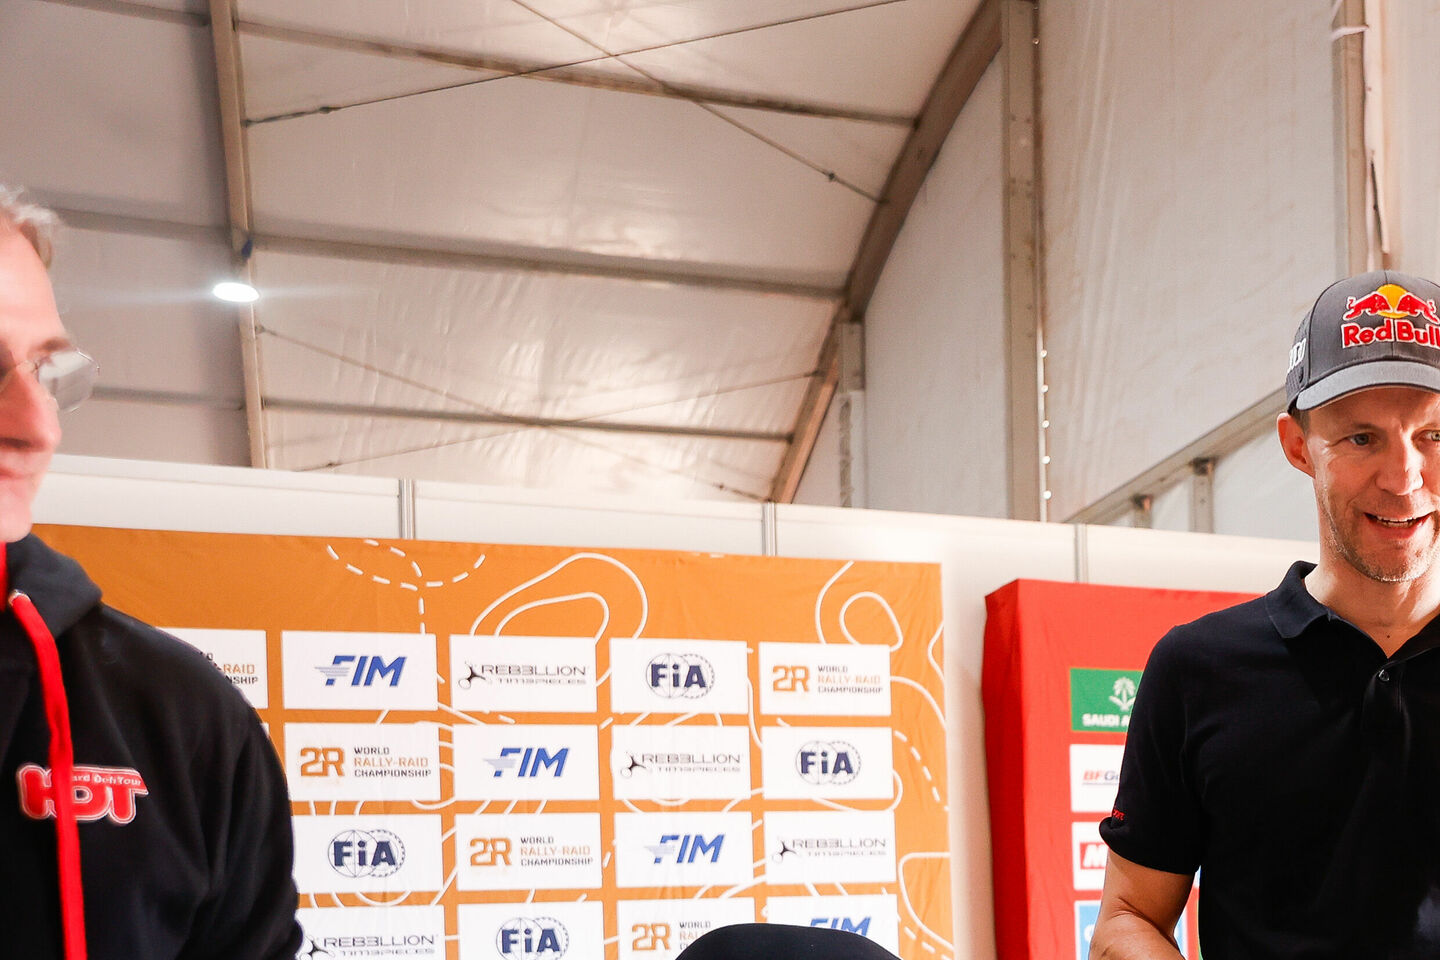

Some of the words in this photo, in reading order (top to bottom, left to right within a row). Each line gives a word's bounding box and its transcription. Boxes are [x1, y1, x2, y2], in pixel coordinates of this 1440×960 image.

[1342, 318, 1393, 349] Red
[320, 655, 408, 687] FIM
[1082, 713, 1120, 727] SAUDI
[354, 747, 390, 755] WORLD
[354, 757, 429, 767] RALLY-RAID
[489, 747, 570, 777] FIM
[354, 769, 431, 777] CHAMPIONSHIP
[520, 836, 555, 844] WORLD
[520, 846, 591, 856] RALLY-RAID
[650, 834, 725, 864] FIM
[520, 858, 593, 866] CHAMPIONSHIP
[680, 921, 711, 930] WORLD
